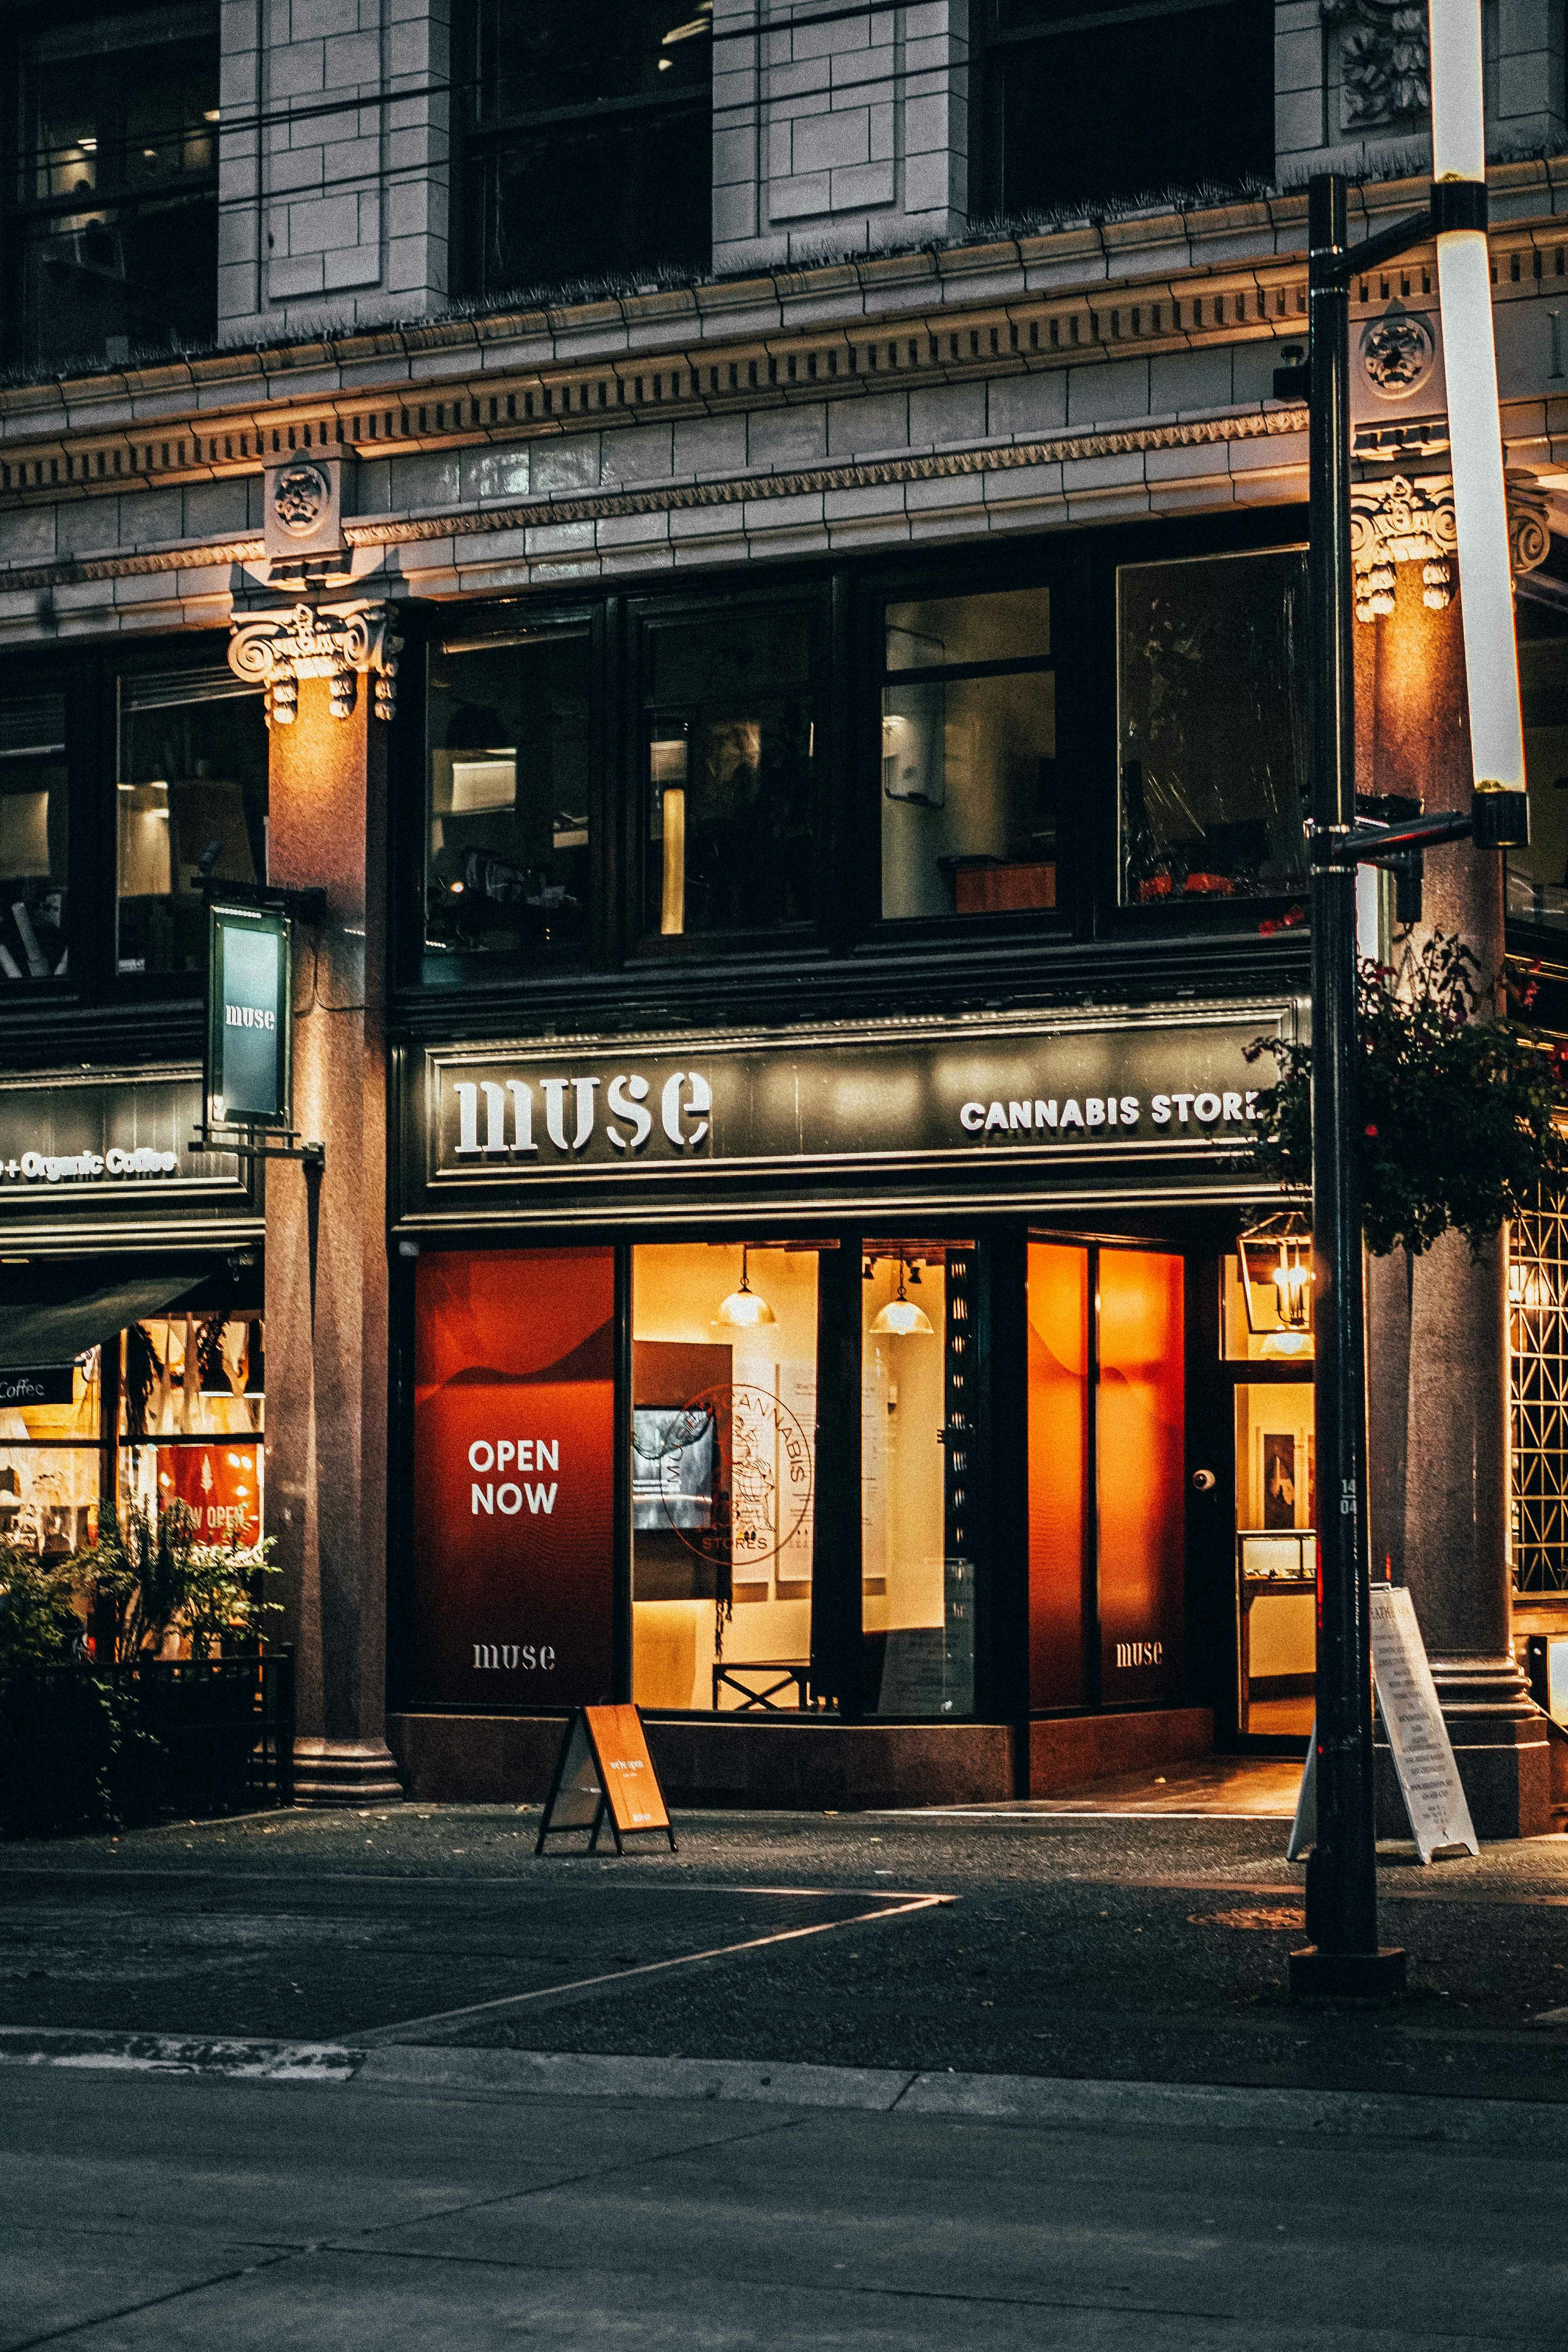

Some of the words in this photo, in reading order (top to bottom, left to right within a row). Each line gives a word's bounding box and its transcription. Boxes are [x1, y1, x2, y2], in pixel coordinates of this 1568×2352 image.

[225, 1004, 275, 1030] muse
[454, 1072, 713, 1153] muse
[960, 1096, 1140, 1130] CANNABIS
[468, 1440, 559, 1472] OPEN
[472, 1483, 558, 1515] NOW
[473, 1644, 555, 1670] muse
[1116, 1642, 1163, 1668] muse
